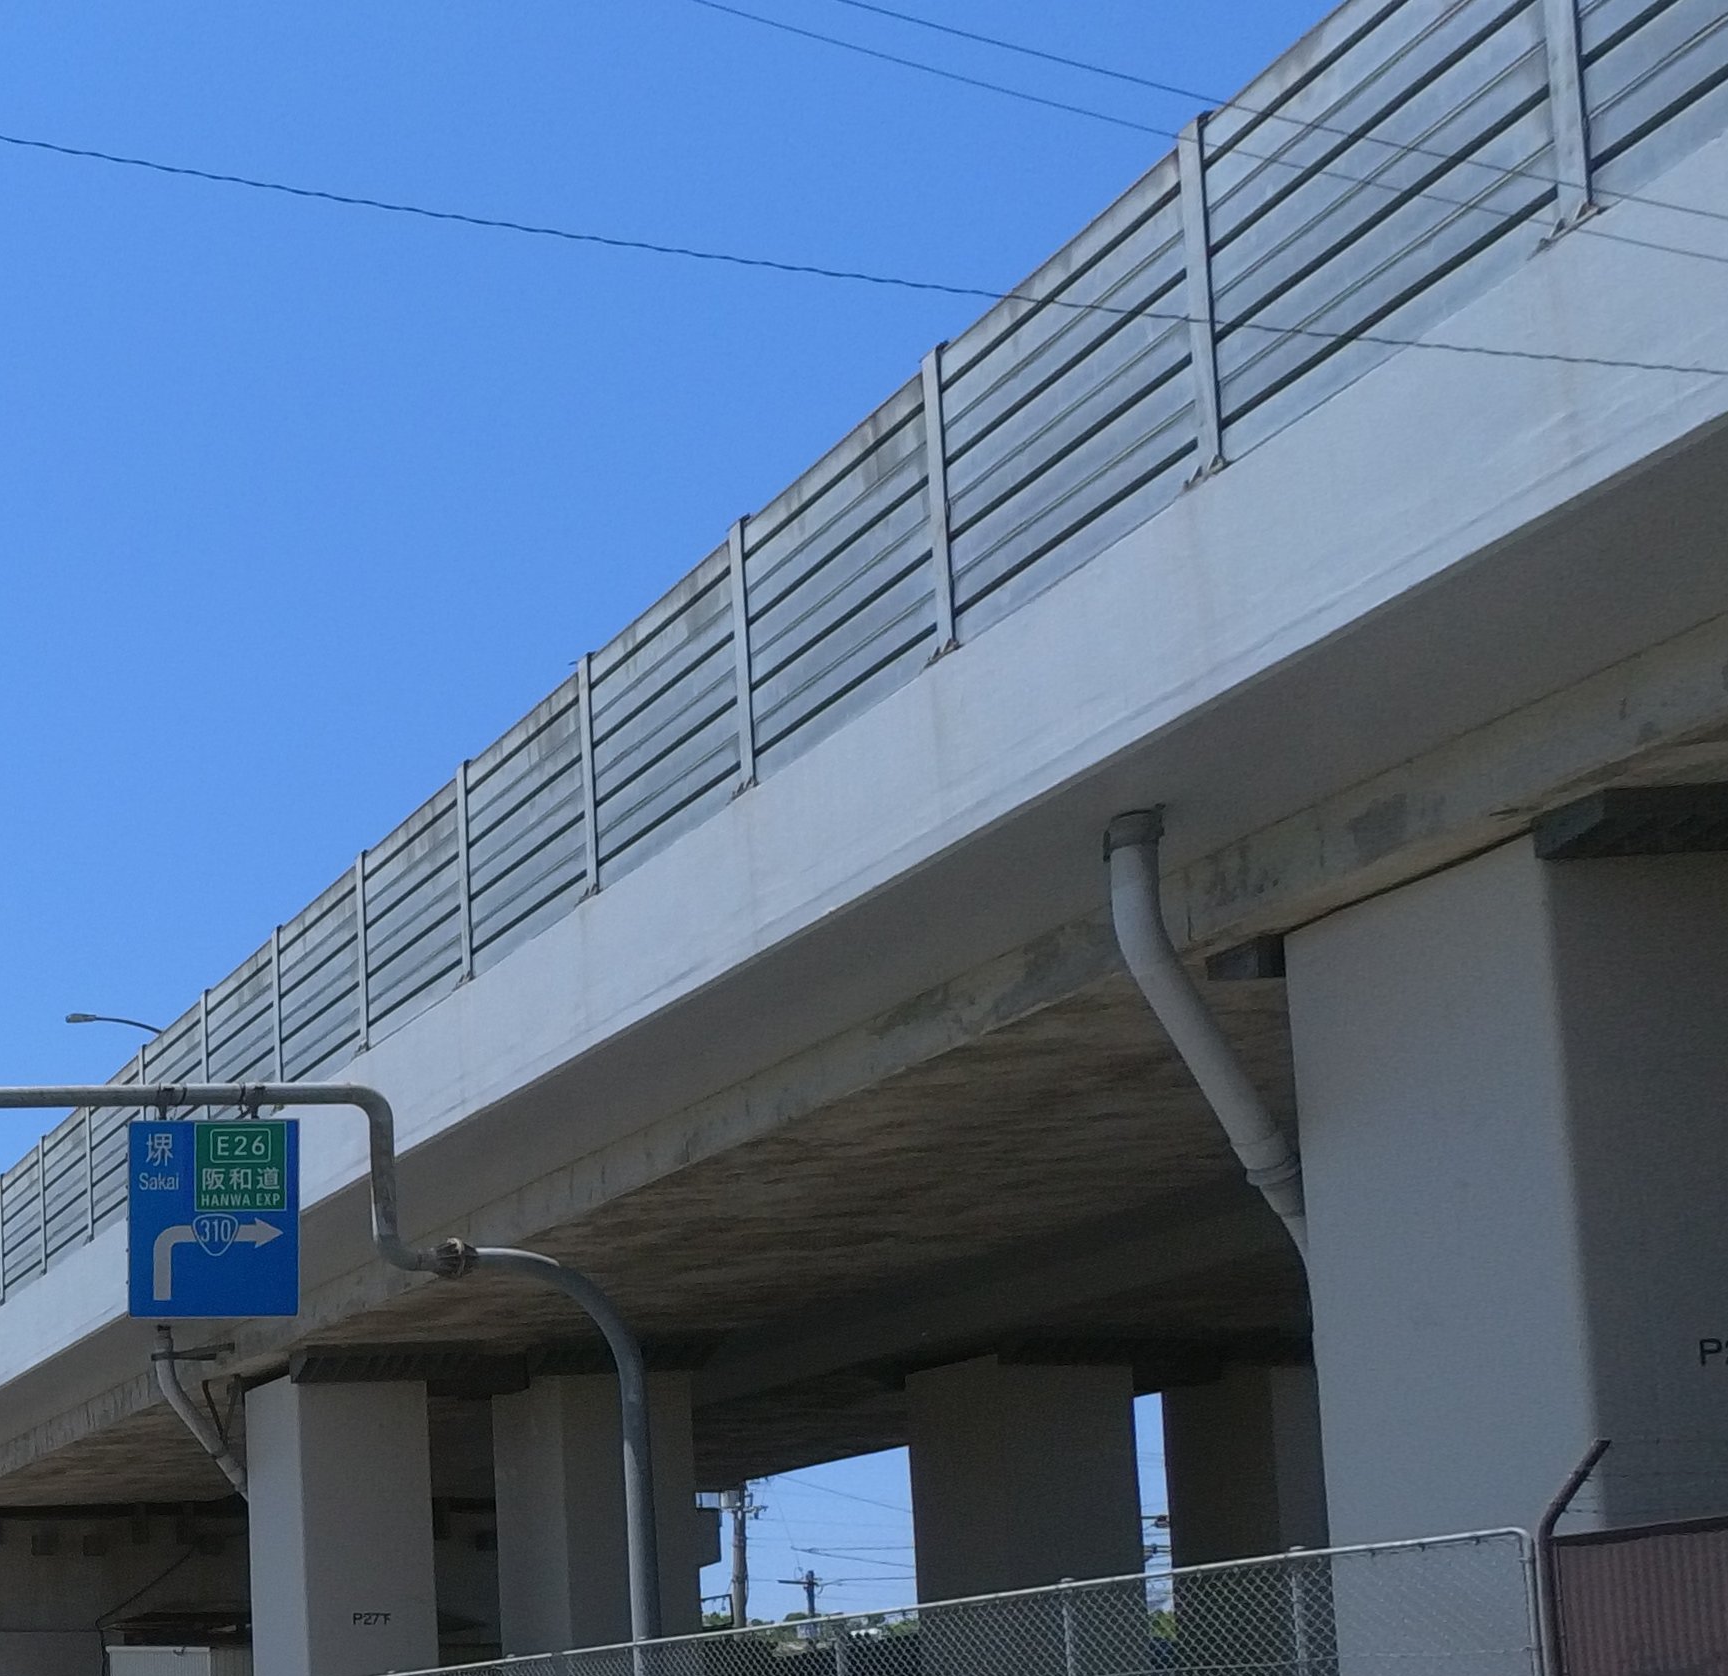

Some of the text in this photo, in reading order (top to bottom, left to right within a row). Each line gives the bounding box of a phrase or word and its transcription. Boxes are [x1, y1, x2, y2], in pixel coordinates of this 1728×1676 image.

[145, 1133, 174, 1166] 堺
[217, 1135, 265, 1156] E26
[139, 1172, 180, 1191] Sakai
[202, 1167, 281, 1191] 阪和道
[201, 1193, 281, 1207] HANWA EXP
[200, 1219, 231, 1243] 310
[1700, 1338, 1728, 1367] P
